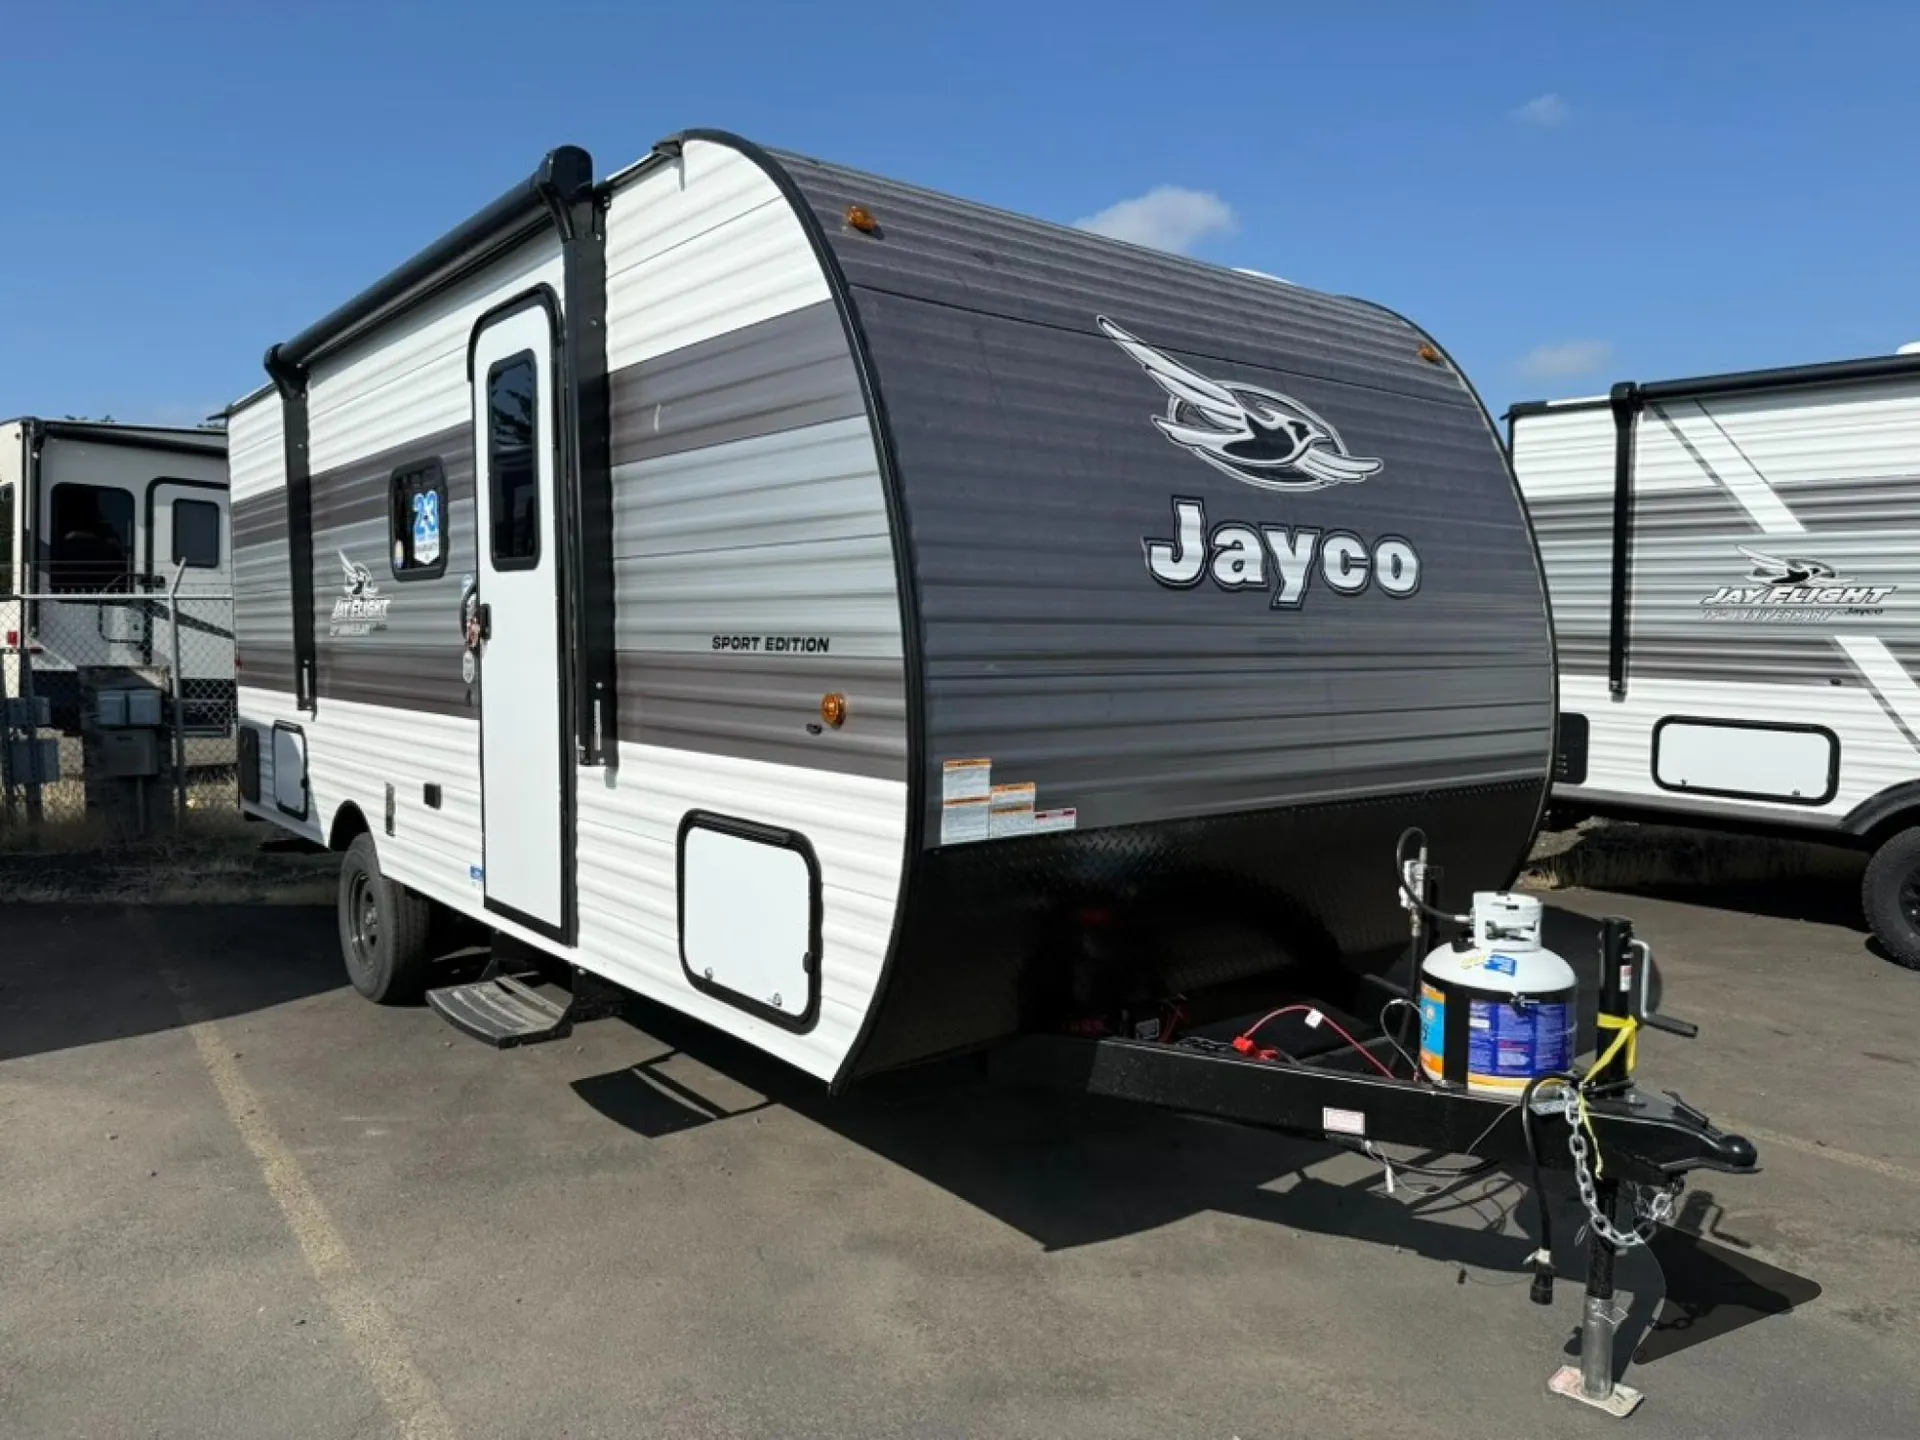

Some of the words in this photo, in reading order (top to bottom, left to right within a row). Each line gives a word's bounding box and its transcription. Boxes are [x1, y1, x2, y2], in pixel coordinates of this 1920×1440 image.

[1143, 496, 1421, 609] Jayco
[1700, 586, 1764, 604] JAY
[1763, 586, 1896, 604] FLIGHT
[711, 634, 760, 652] SPORT
[765, 636, 830, 653] EDITION
